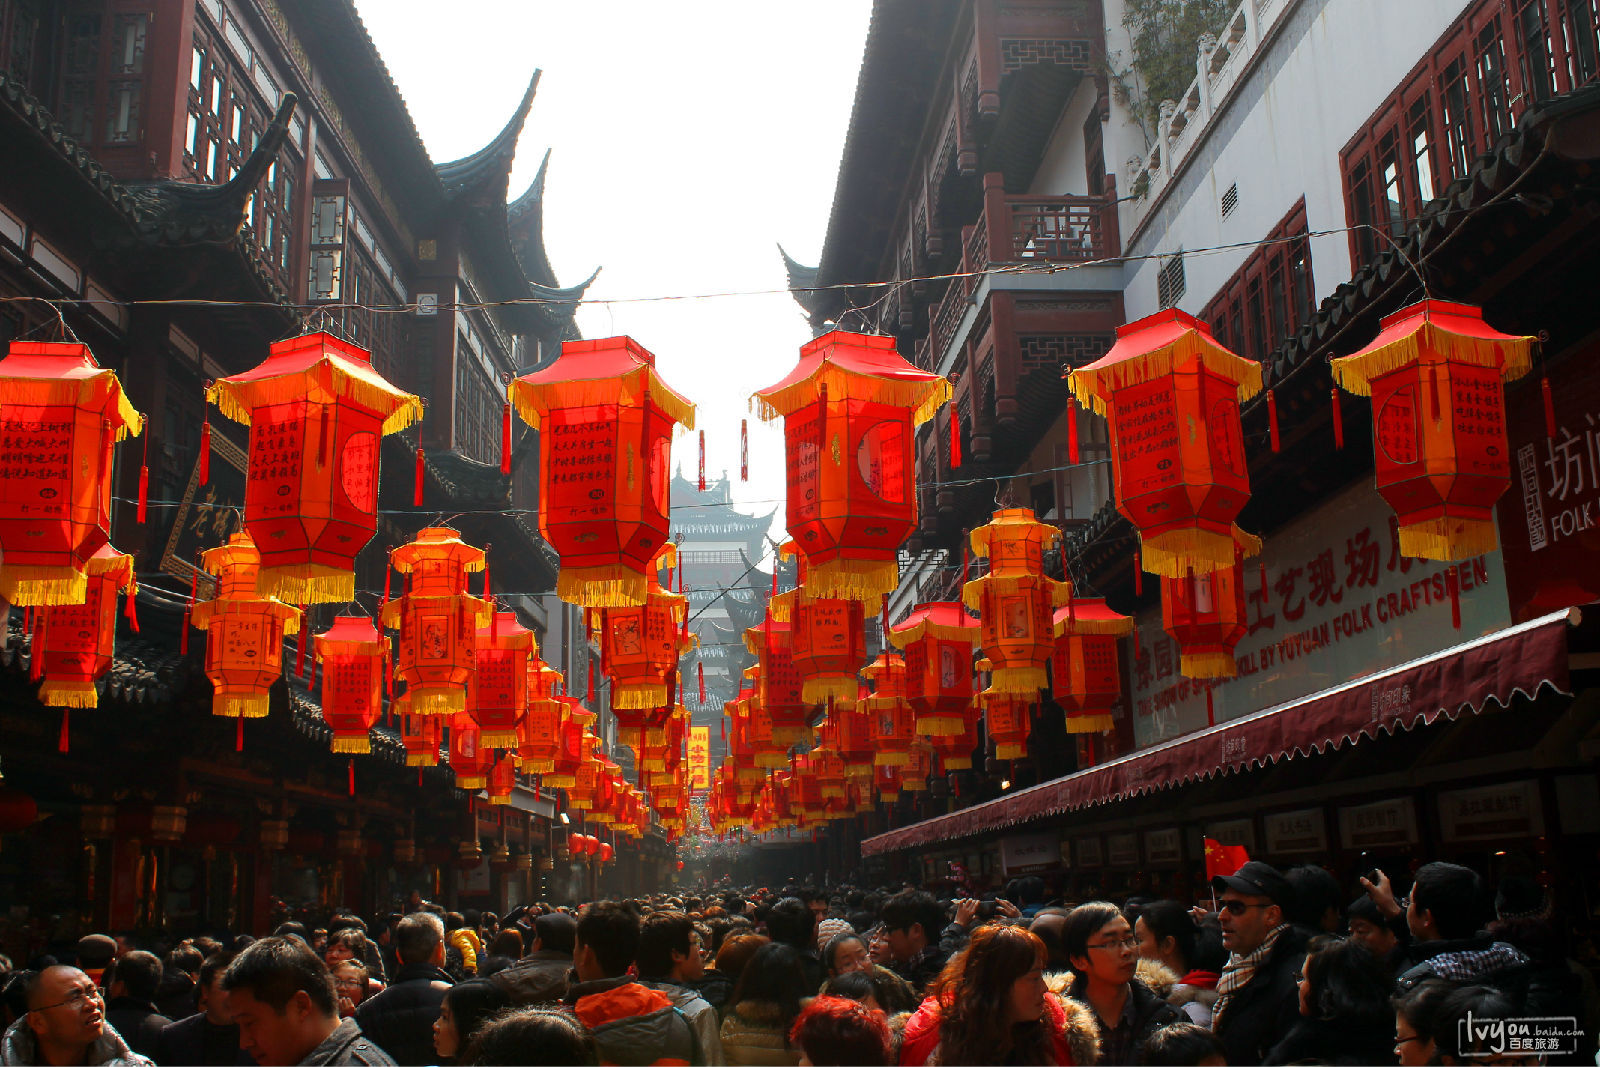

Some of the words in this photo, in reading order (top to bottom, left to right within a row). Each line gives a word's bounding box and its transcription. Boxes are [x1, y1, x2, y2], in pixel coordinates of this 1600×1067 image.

[1552, 501, 1597, 543] FOLK
[1177, 679, 1191, 702] OF
[1259, 643, 1276, 671] BY
[1278, 620, 1331, 665] YUYUAN
[1333, 602, 1374, 643] FOLK
